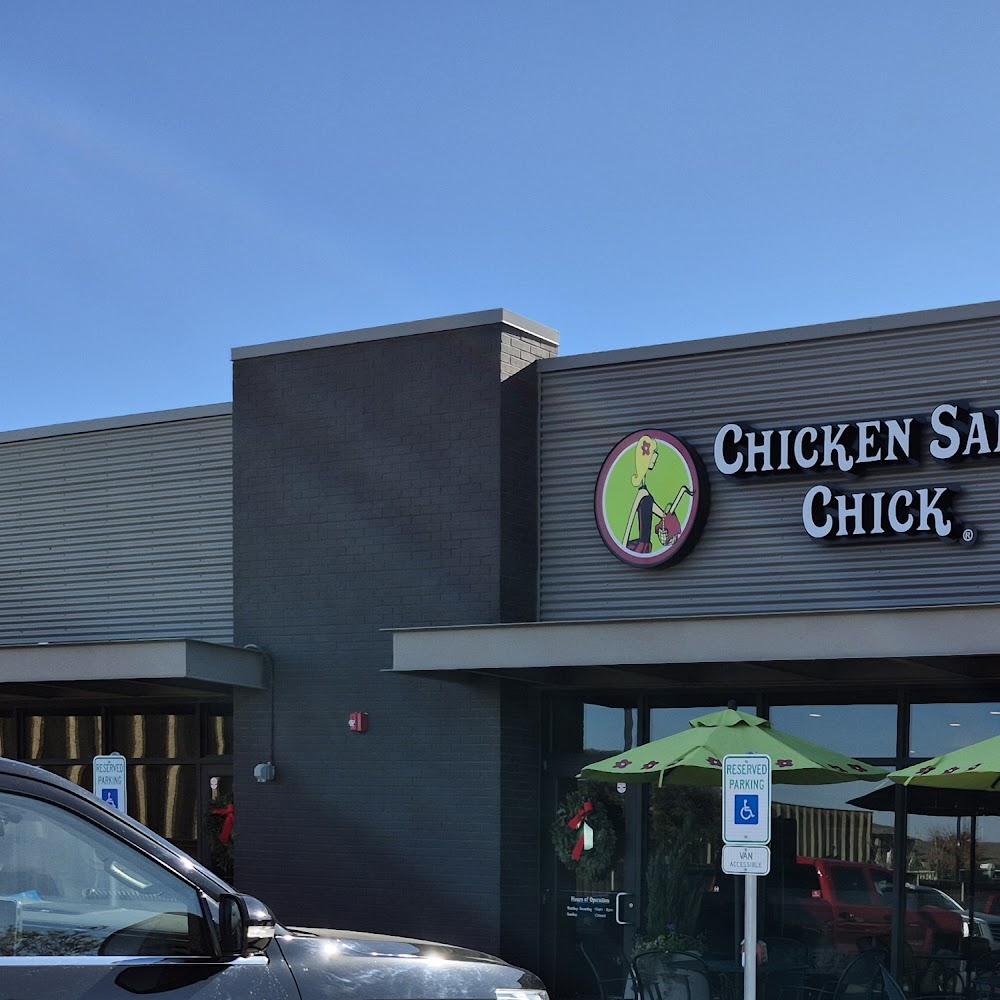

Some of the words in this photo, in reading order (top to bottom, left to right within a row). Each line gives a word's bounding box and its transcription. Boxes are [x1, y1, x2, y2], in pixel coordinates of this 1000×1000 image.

[713, 418, 913, 474] CHICKEN
[802, 484, 953, 539] CHICK
[96, 763, 123, 773] RESERVED
[726, 764, 768, 775] RESERVED
[98, 776, 122, 785] PARKING
[729, 779, 765, 790] PARKING
[739, 852, 753, 860] VAN
